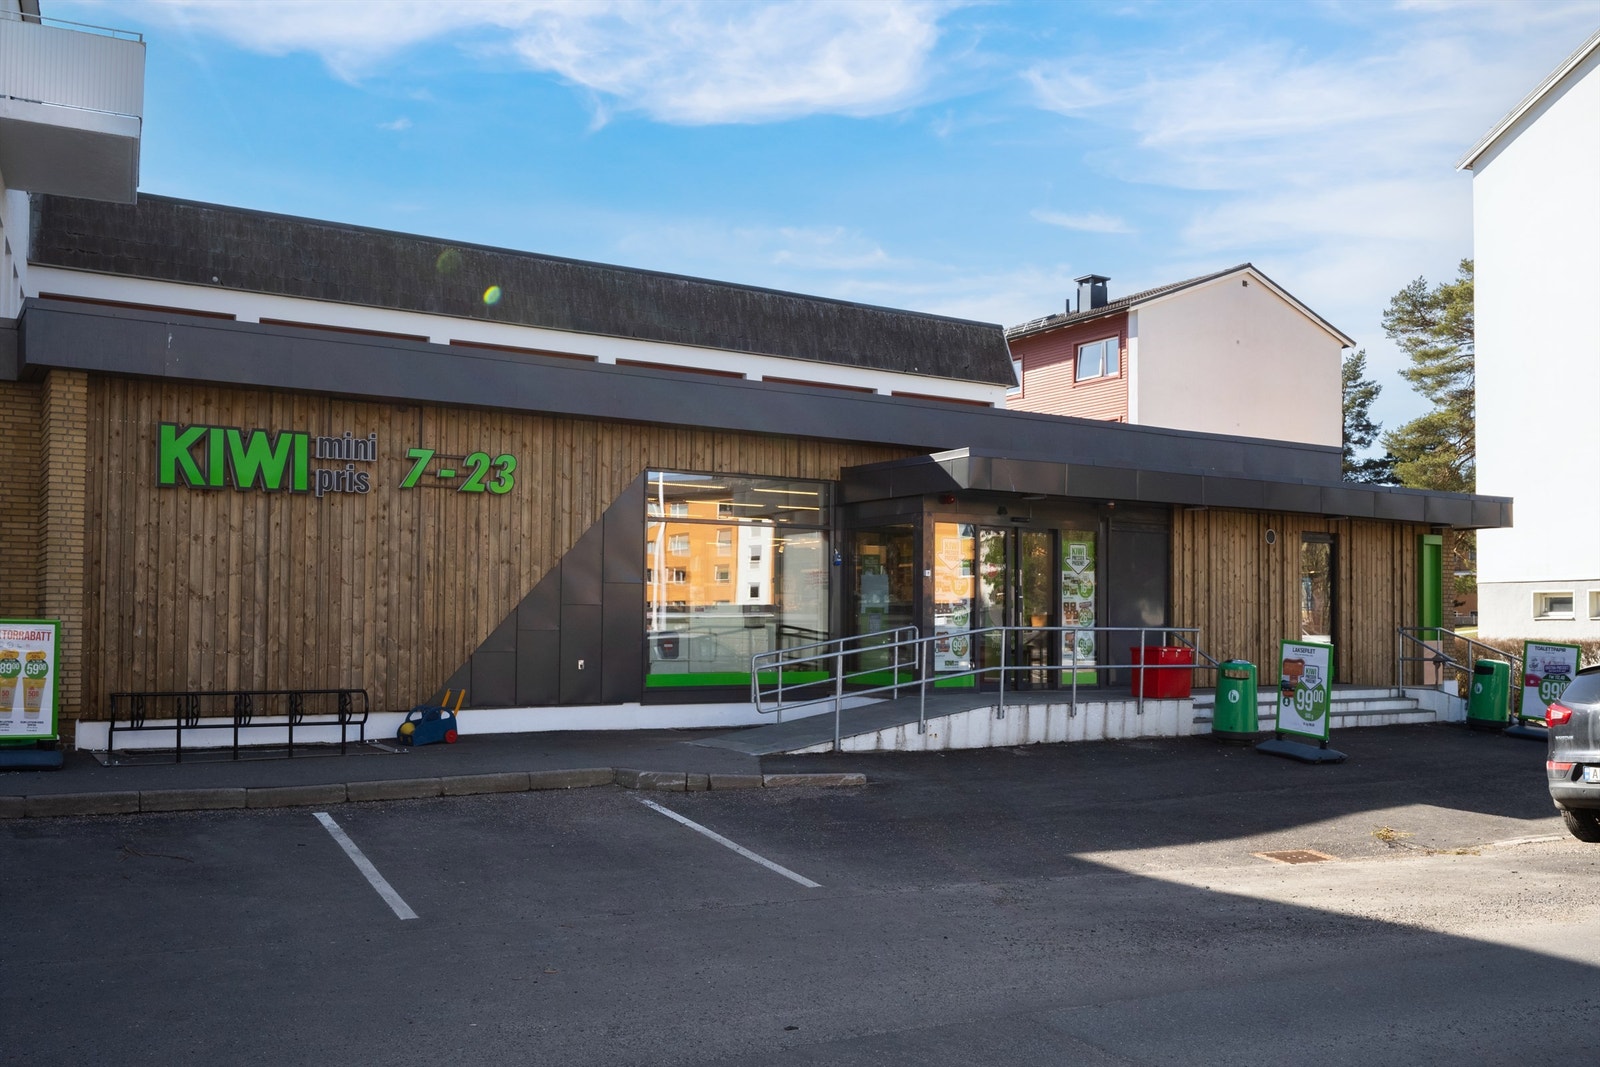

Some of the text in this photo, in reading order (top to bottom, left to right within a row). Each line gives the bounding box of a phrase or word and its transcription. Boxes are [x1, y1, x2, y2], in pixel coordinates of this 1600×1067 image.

[157, 422, 311, 493] KIWI
[315, 431, 377, 461] mini
[315, 464, 371, 497] pris
[1292, 647, 1316, 655] LAKSEFILET
